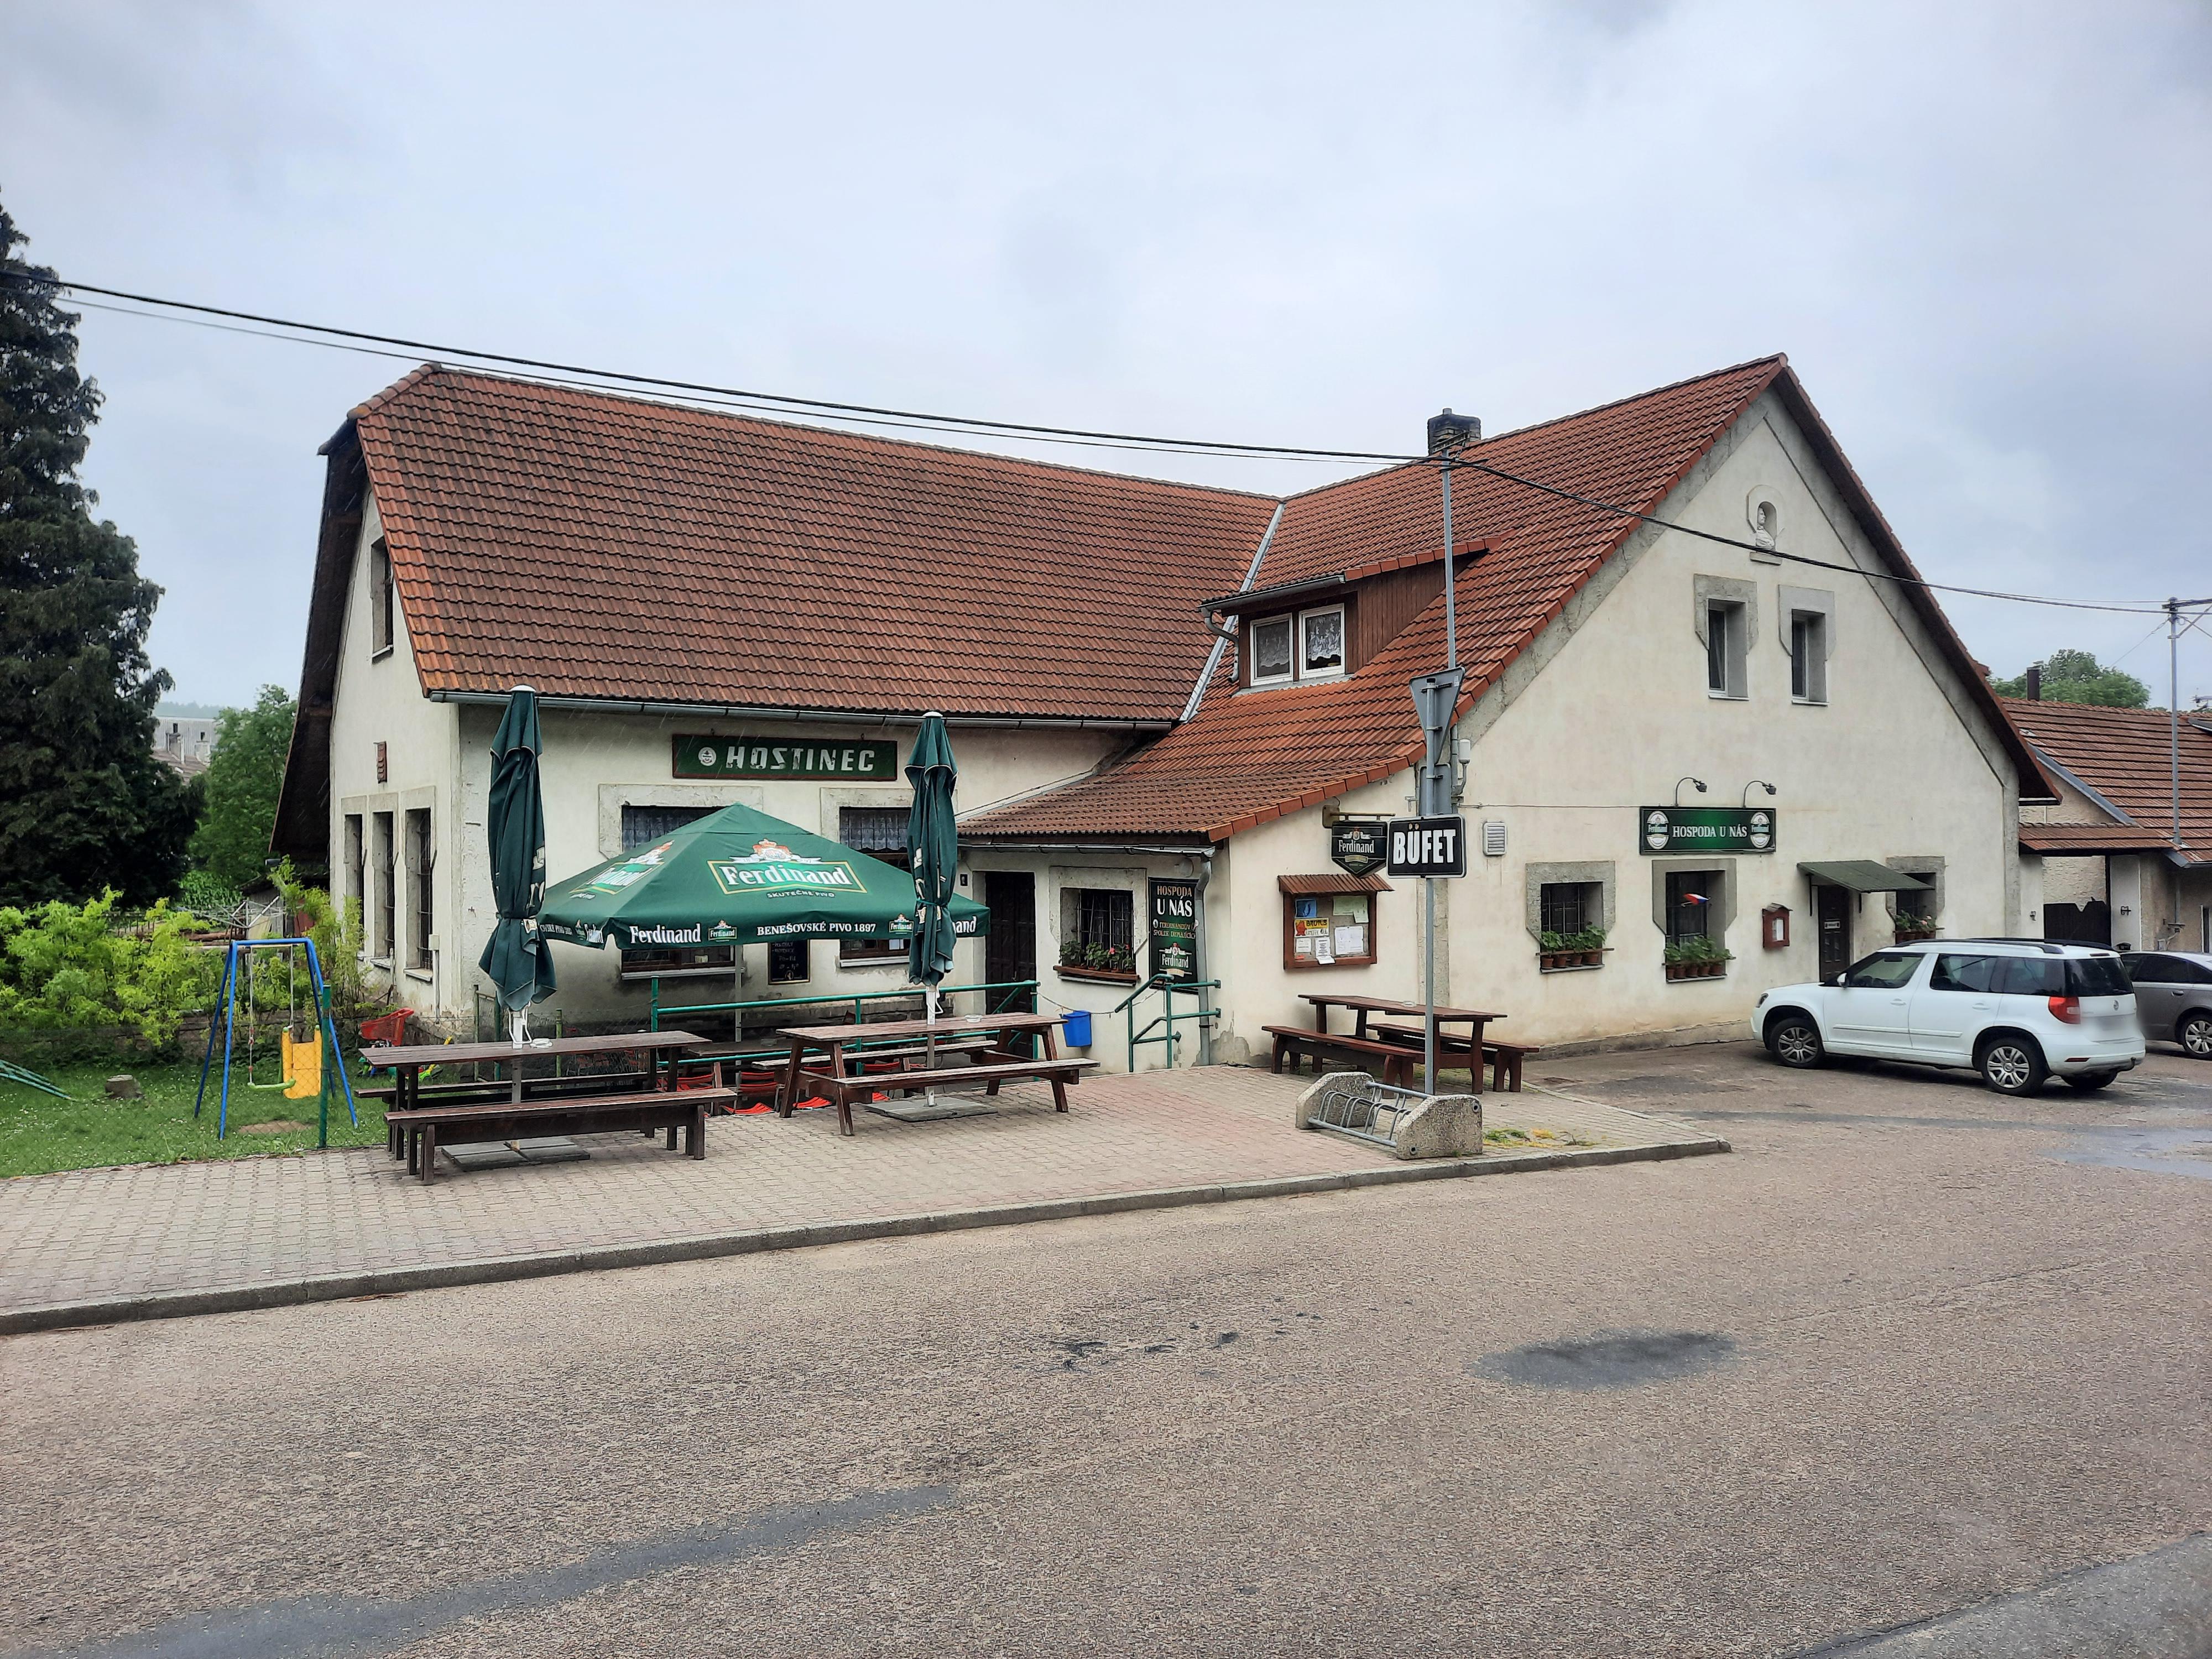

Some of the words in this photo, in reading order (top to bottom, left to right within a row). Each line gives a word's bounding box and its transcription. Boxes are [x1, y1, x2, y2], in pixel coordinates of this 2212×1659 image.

[726, 746, 875, 771] HOSTINEC
[1672, 826, 1717, 837] HOSPODA
[1720, 826, 1726, 837] U
[1729, 823, 1747, 837] NÁS
[1338, 839, 1375, 853] Ferdinand
[719, 864, 853, 885] Ferdinand
[1157, 885, 1192, 897] HOSPODA
[1157, 898, 1165, 915] U
[1169, 896, 1192, 917] NÁS
[629, 923, 701, 943] Ferdinand
[710, 929, 735, 938] Ferdinand
[757, 921, 826, 936] BENEŠOVSKÉ
[830, 923, 852, 932] PIVO
[854, 923, 876, 932] 1897
[1162, 953, 1189, 968] Ferdinand
